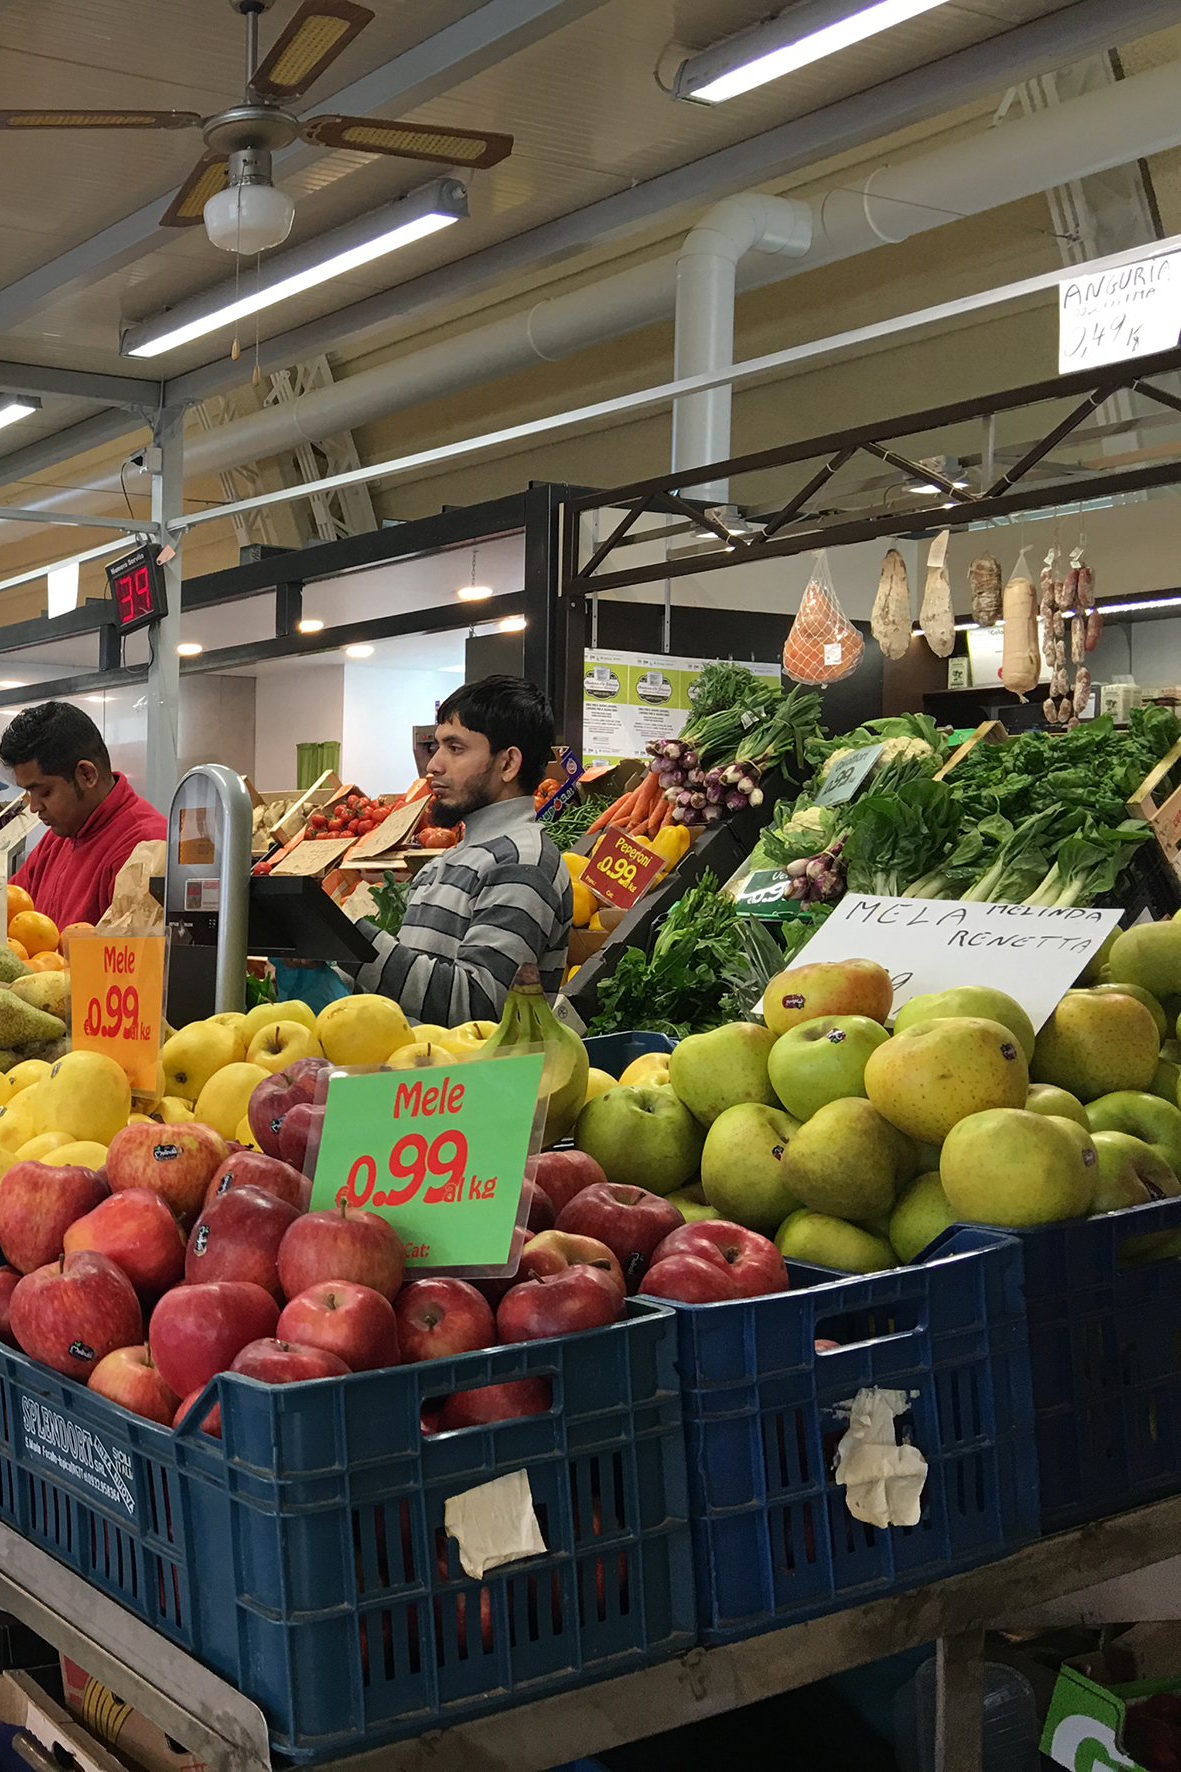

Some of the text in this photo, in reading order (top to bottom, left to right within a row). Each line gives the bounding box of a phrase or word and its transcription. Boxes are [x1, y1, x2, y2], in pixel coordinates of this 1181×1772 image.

[1063, 259, 1171, 310] ANGURIA
[1063, 313, 1127, 358] 0,49
[110, 553, 145, 575] Numero Servito
[119, 566, 150, 622] 39
[615, 837, 654, 868] Peperoni
[845, 900, 1103, 927] MELA MELINDA
[947, 929, 1092, 954] RENETTA
[104, 945, 135, 974] Mele
[140, 1021, 151, 1041] kg
[393, 1077, 466, 1119] Mele
[469, 1175, 498, 1201] kg
[21, 1395, 95, 1470] SPLENDORT
